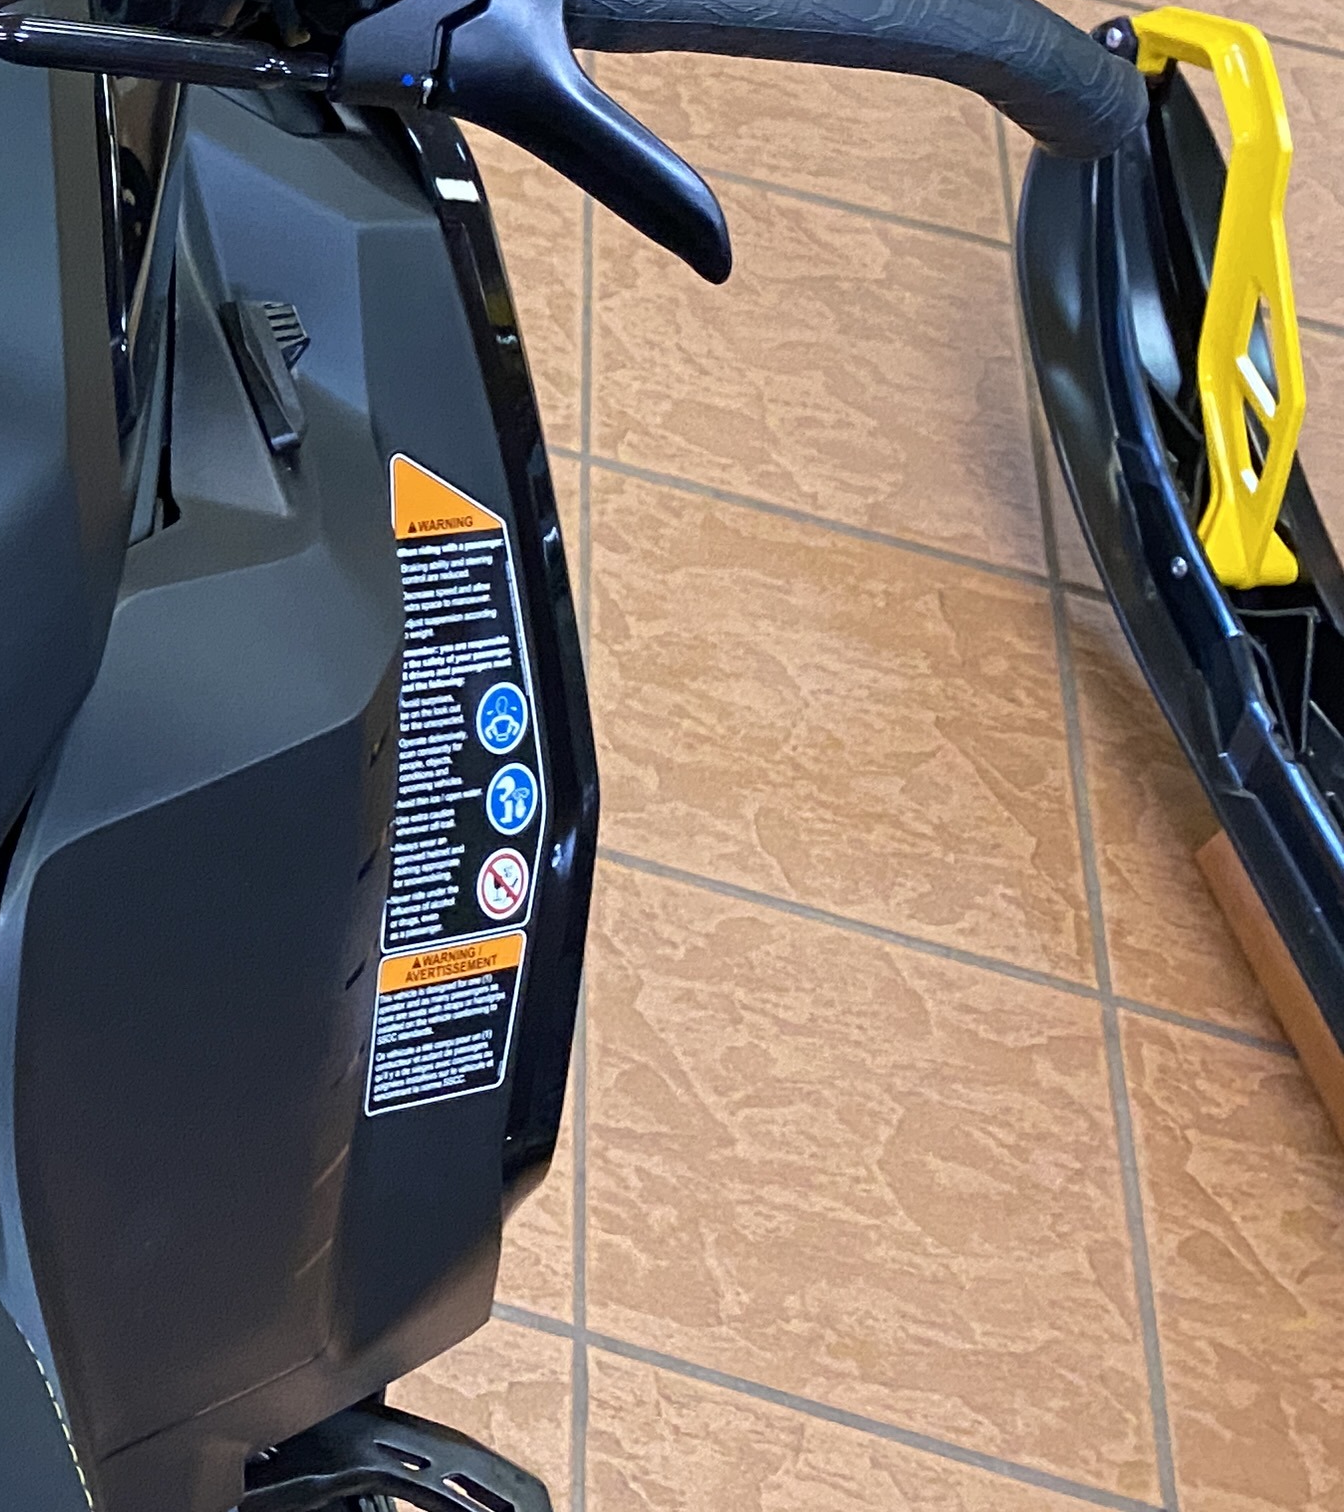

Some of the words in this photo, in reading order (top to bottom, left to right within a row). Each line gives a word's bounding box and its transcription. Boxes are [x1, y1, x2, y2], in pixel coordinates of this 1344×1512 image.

[418, 516, 473, 532] WARNING
[423, 947, 476, 966] WARNING
[405, 954, 498, 982] AVERTISSEMENT
